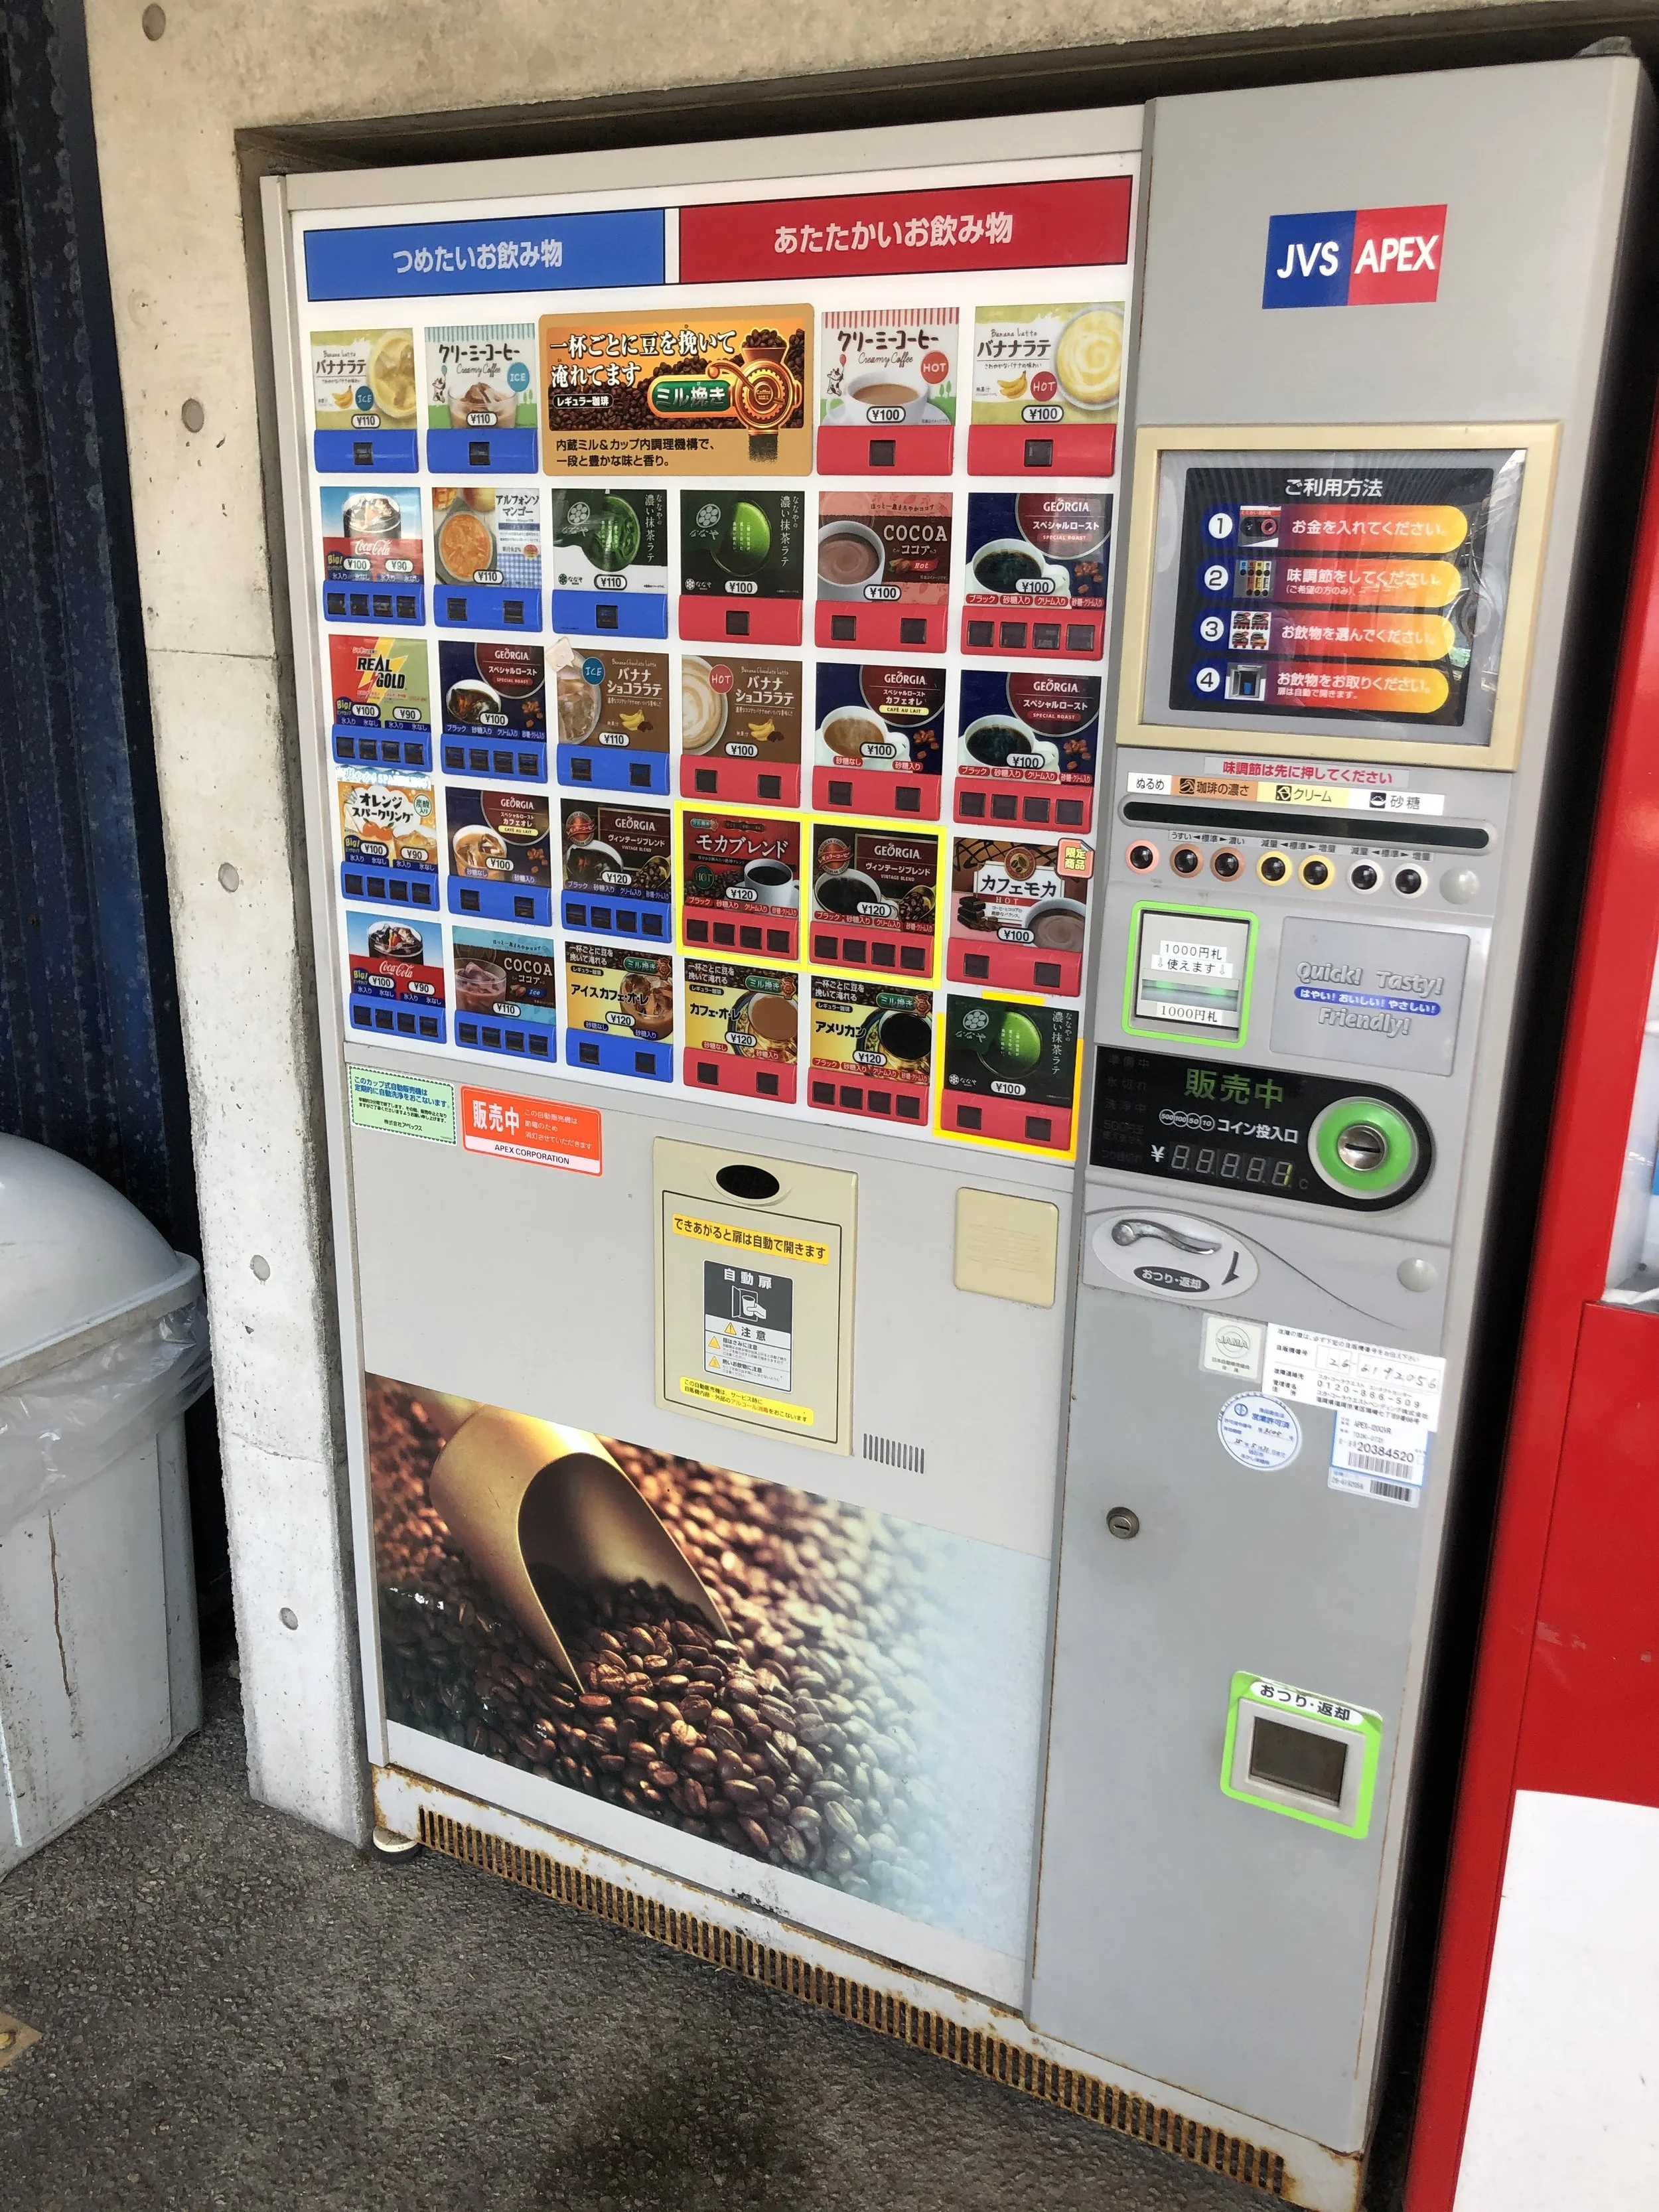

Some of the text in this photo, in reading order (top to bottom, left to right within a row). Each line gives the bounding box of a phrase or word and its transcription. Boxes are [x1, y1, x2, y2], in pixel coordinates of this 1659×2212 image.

[774, 212, 1013, 255] あたたかいお飲み物
[393, 239, 563, 273] つめたいお飲み物
[1277, 235, 1439, 279] JVS APEX
[549, 329, 737, 359] 一杯ごとに豆を挽いて
[837, 329, 939, 352] クリーミーコーヒー
[977, 340, 1051, 358] バナナラテ
[439, 343, 520, 363] クリーミーコーヒー
[316, 360, 366, 374] バナナラテ
[551, 362, 642, 389] 淹れてます
[922, 362, 947, 372] HOT
[510, 373, 526, 382] ICE
[1033, 381, 1055, 393] HOT
[357, 394, 373, 404] ICE
[557, 396, 609, 407] レギュラー珈琲
[655, 386, 726, 408] ミル挽き
[356, 416, 375, 426] ¥110
[470, 414, 490, 424] ¥110
[872, 408, 900, 420] ¥100
[1029, 407, 1058, 420] ¥100
[556, 455, 669, 467] 一段と豊かな味と香り。
[1285, 478, 1384, 498] ご利用方法
[496, 494, 540, 506] アルフォンソ
[1043, 498, 1090, 512] GEORGIA
[502, 507, 534, 518] マンゴー
[644, 494, 656, 563] 濃い抹茶ラテ
[780, 495, 791, 567] 濃い抹茶ラテ
[883, 525, 948, 543] COCOA
[1033, 520, 1100, 531] スペシャルロースト
[1216, 518, 1448, 536] 1 お金を入れてください。
[901, 544, 931, 556] ココア
[913, 561, 929, 570] Hot
[1208, 567, 1442, 587] 2 味調節をしてください。
[970, 595, 1066, 606] ブラック 砂糖入り クリーム入り
[1204, 621, 1435, 646] 3 お飲物を選んでください。
[494, 648, 530, 660] GEORGIA
[356, 654, 392, 672] REAL
[488, 666, 538, 676] スペシャルロースト
[376, 673, 405, 690] GOLD
[617, 668, 651, 682] バナナ
[711, 674, 732, 686] HOT
[747, 677, 784, 690] バナナ
[1200, 672, 1431, 694] 4 お飲物をお取りください。
[607, 682, 663, 697] ショコララテ
[735, 689, 794, 705] ショコララテ
[1276, 688, 1358, 700] 扉は自動で開きます。
[885, 696, 922, 706] カフェオレ
[400, 709, 416, 719] ¥90
[835, 757, 862, 766] 砂糖なし
[1222, 761, 1393, 784] 味調節は先に押してください
[359, 793, 402, 810] オレンジ
[1136, 777, 1421, 810] ぬるめ 珈琲の濃さ クリーム 砂糖
[352, 806, 413, 824] スパークリング
[503, 818, 533, 828] カフェオレ
[608, 834, 665, 847] ヴィンテージブレンド
[695, 834, 788, 860] モカブレンド
[1065, 846, 1086, 859] 限定
[865, 862, 931, 877] ヴィンテージブレンド
[1064, 857, 1086, 871] 商品
[607, 873, 628, 884] ¥120
[979, 873, 1058, 899] カフェモカ
[731, 888, 753, 900] ¥120
[861, 903, 886, 916] ¥120
[569, 945, 613, 957] 一杯ごとに豆を
[569, 952, 607, 966] 挽いて淹れる
[1163, 943, 1223, 961] 1000円札
[504, 957, 553, 977] COCOA
[627, 961, 656, 972] ミル挽き
[688, 964, 735, 976] 一杯ごとに豆を
[1167, 960, 1216, 975] 使えます
[518, 974, 540, 985] ココア
[688, 972, 728, 984] 挽いて淹れる
[1296, 962, 1445, 996] Quick! Tasty!
[571, 984, 649, 1005] アイスカフェ・オ・レ
[690, 1003, 741, 1021] カフェ・オ・レ
[1160, 1005, 1218, 1023] 1000円札
[814, 1020, 867, 1039] アメリカン
[1318, 1007, 1411, 1037] Friendly!
[1050, 1011, 1063, 1075] 濃い抹茶ラテ
[354, 1076, 427, 1096] このカップ式自動販売機は
[1185, 1068, 1284, 1110] 販売中
[472, 1099, 520, 1136] 販売中
[524, 1108, 579, 1125] この自動販売機は
[525, 1120, 558, 1132] 節電のため
[1217, 1118, 1299, 1144] コイン投入口
[524, 1131, 593, 1151] 消灯させていただきます
[495, 1143, 569, 1165] APEX CORPORATION
[673, 1217, 827, 1260] できあがると扉は自動で開きます
[1141, 1268, 1202, 1290] おつり・返却
[1317, 1380, 1420, 1408] 0120-866-509
[1357, 1441, 1413, 1462] 20384520
[1260, 1684, 1351, 1722] おつり・返却
